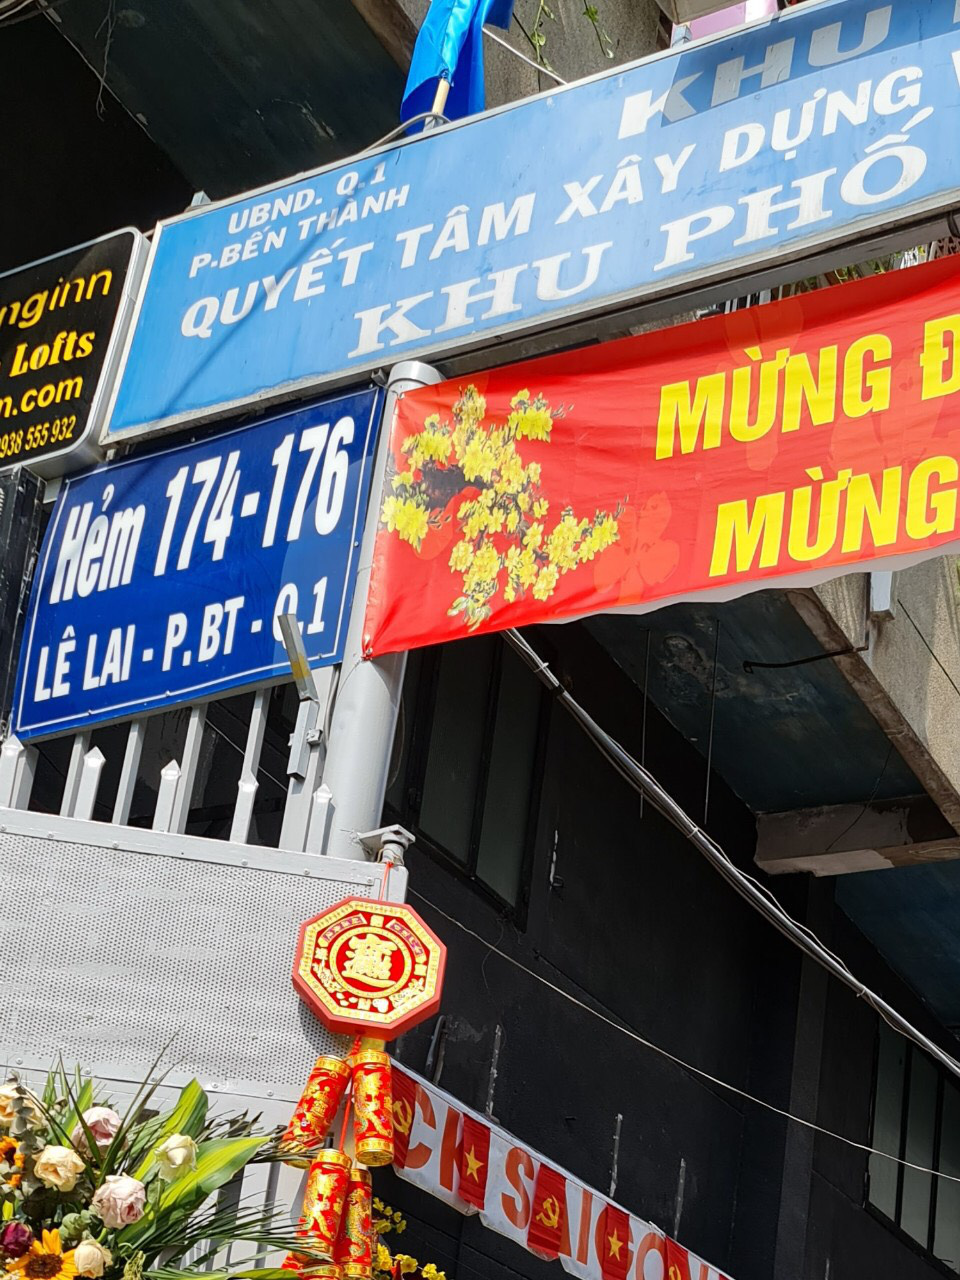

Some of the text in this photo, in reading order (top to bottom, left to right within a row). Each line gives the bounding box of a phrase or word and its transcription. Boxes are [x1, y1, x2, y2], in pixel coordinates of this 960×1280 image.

[618, 5, 893, 140] KHU
[180, 237, 374, 339] QUYẾT
[396, 203, 536, 270] TÂM
[555, 143, 696, 225] XÂY
[719, 66, 923, 173] DỰNG
[228, 187, 323, 235] UBND.
[298, 184, 411, 241] THÀNH
[347, 240, 613, 359] KHU
[653, 106, 934, 272] PHỐ
[9, 330, 96, 378] Lofts
[655, 332, 894, 460] MỪNG
[0, 414, 77, 458] 938 555 932
[49, 415, 355, 605] Hẻm 174-176
[708, 455, 960, 577] MỪNG
[33, 624, 77, 703] LÊ
[82, 623, 136, 692] LAI
[161, 595, 245, 672] P.BT
